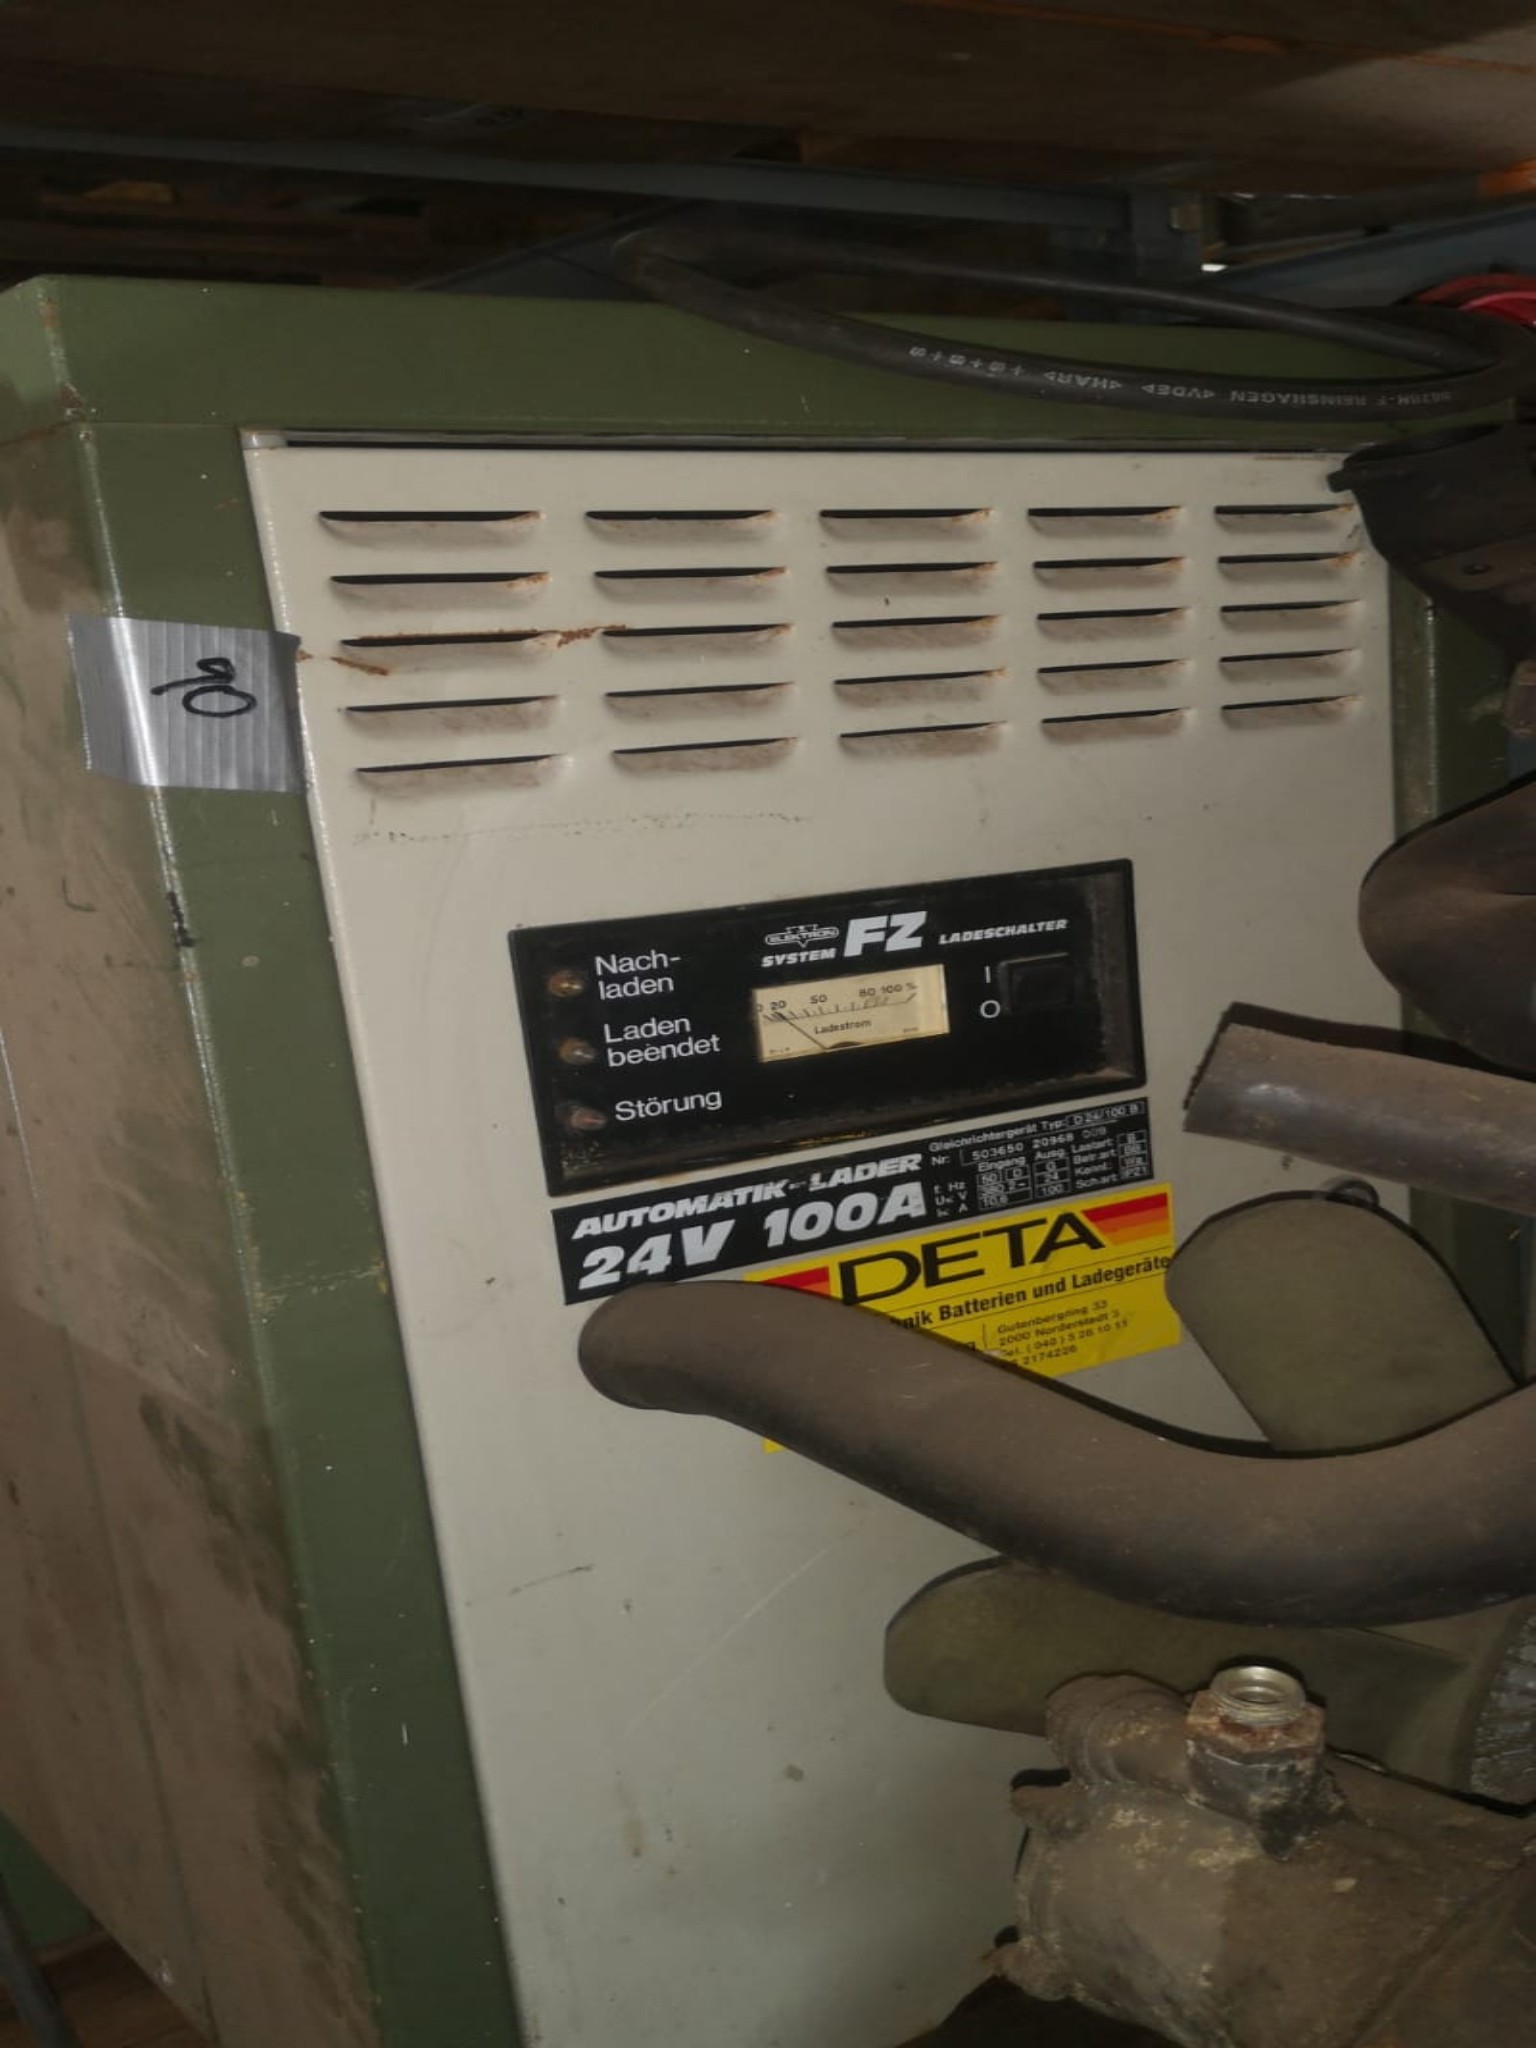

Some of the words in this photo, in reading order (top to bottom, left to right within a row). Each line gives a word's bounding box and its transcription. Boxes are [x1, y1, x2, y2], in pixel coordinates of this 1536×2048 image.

[761, 947, 837, 968] SYSTEM
[844, 910, 927, 957] FZ
[938, 918, 1069, 945] LADESCHALTER
[594, 949, 682, 976] Nach-
[598, 973, 675, 1001] laden
[769, 999, 787, 1012] 20
[809, 993, 828, 1005] 50
[858, 985, 877, 998] 80
[603, 1015, 691, 1044] Laden
[814, 1018, 872, 1036] Ladestrom
[607, 1033, 721, 1067] beendet
[614, 1090, 723, 1122] Störung
[763, 1181, 927, 1248] 100A
[838, 1211, 1106, 1306] DETA
[939, 1289, 1027, 1322] Batterien
[1032, 1278, 1066, 1299] und
[1072, 1254, 1171, 1290] Ladegeräte
